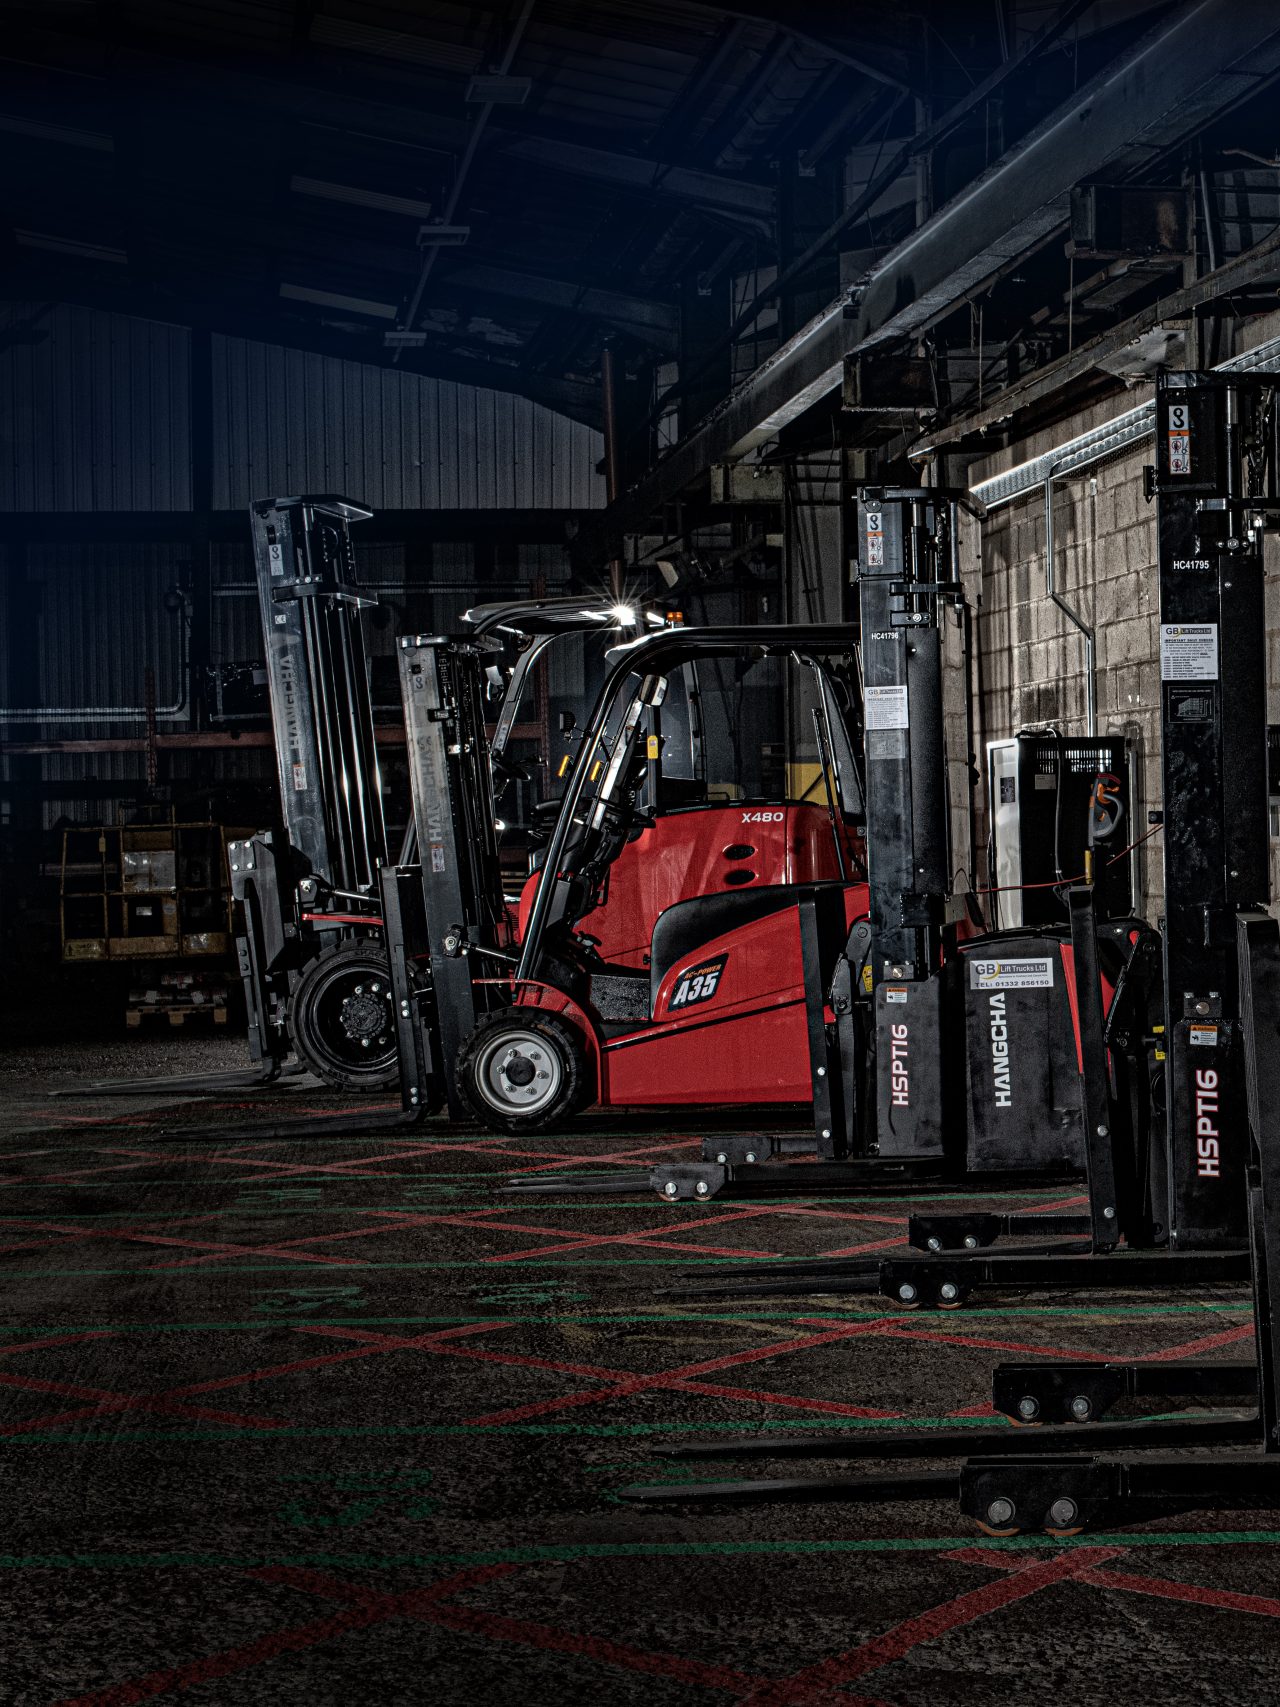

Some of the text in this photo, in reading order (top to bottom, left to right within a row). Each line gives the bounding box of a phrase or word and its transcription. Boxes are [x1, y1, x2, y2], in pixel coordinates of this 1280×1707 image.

[1173, 560, 1210, 570] HC41795
[1165, 627, 1179, 635] GB
[741, 811, 784, 824] X480
[975, 963, 996, 975] GB
[1000, 965, 1011, 973] Lift
[672, 971, 719, 1005] A35
[990, 992, 1012, 1107] HANGCHA
